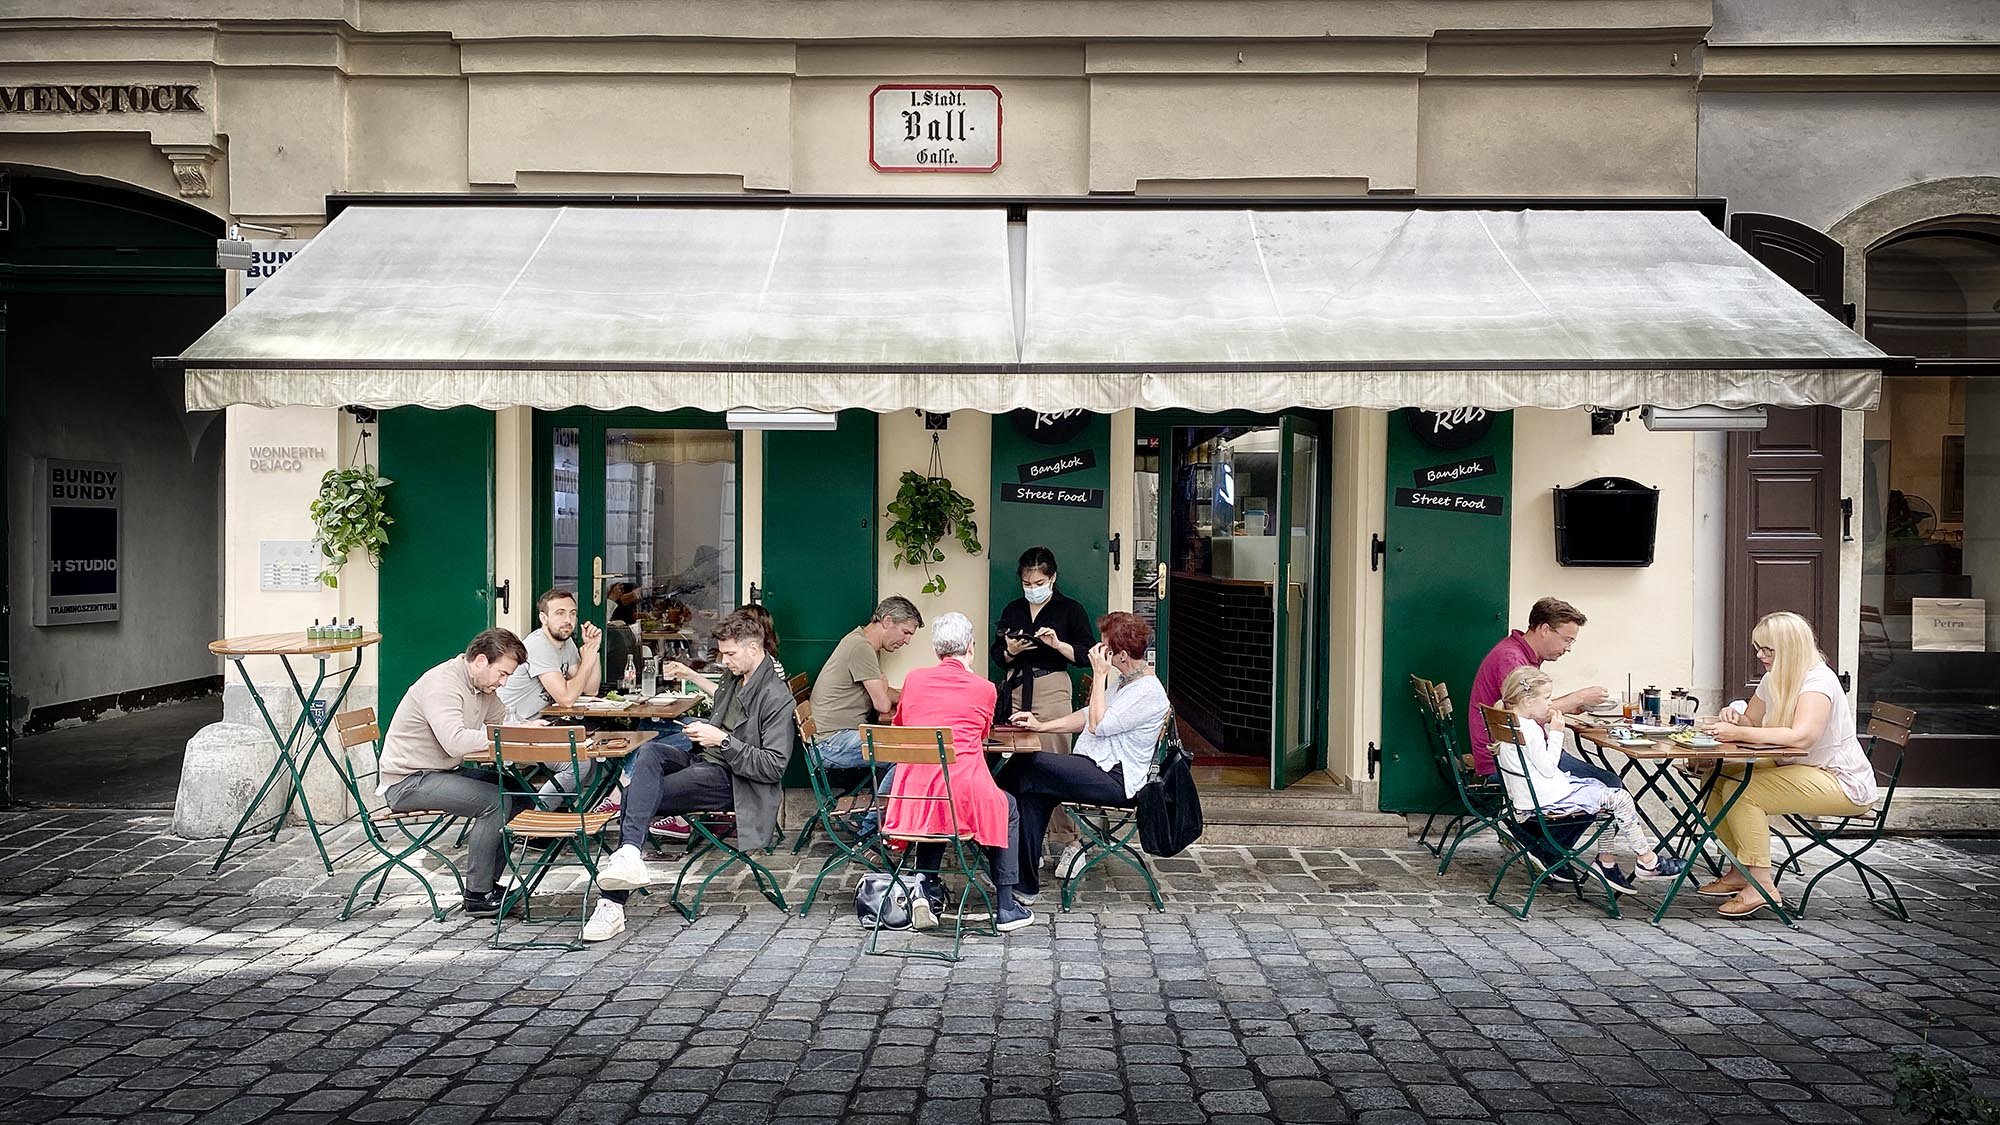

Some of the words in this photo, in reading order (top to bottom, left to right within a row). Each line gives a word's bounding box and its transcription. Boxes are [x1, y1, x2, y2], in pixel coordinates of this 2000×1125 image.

[901, 108, 975, 142] Ball-
[251, 251, 298, 264] BUN
[249, 446, 325, 460] WONNERTH
[1030, 456, 1083, 476] Bangkok
[1427, 462, 1483, 481] Bangkok
[53, 469, 118, 485] BUNDY
[53, 484, 118, 500] BUNDY
[1017, 488, 1054, 500] Street
[1057, 490, 1088, 503] Food
[1411, 493, 1452, 506] Street
[1454, 496, 1487, 509] Food
[65, 558, 118, 573] STUDIO
[1934, 618, 1965, 628] Petra
